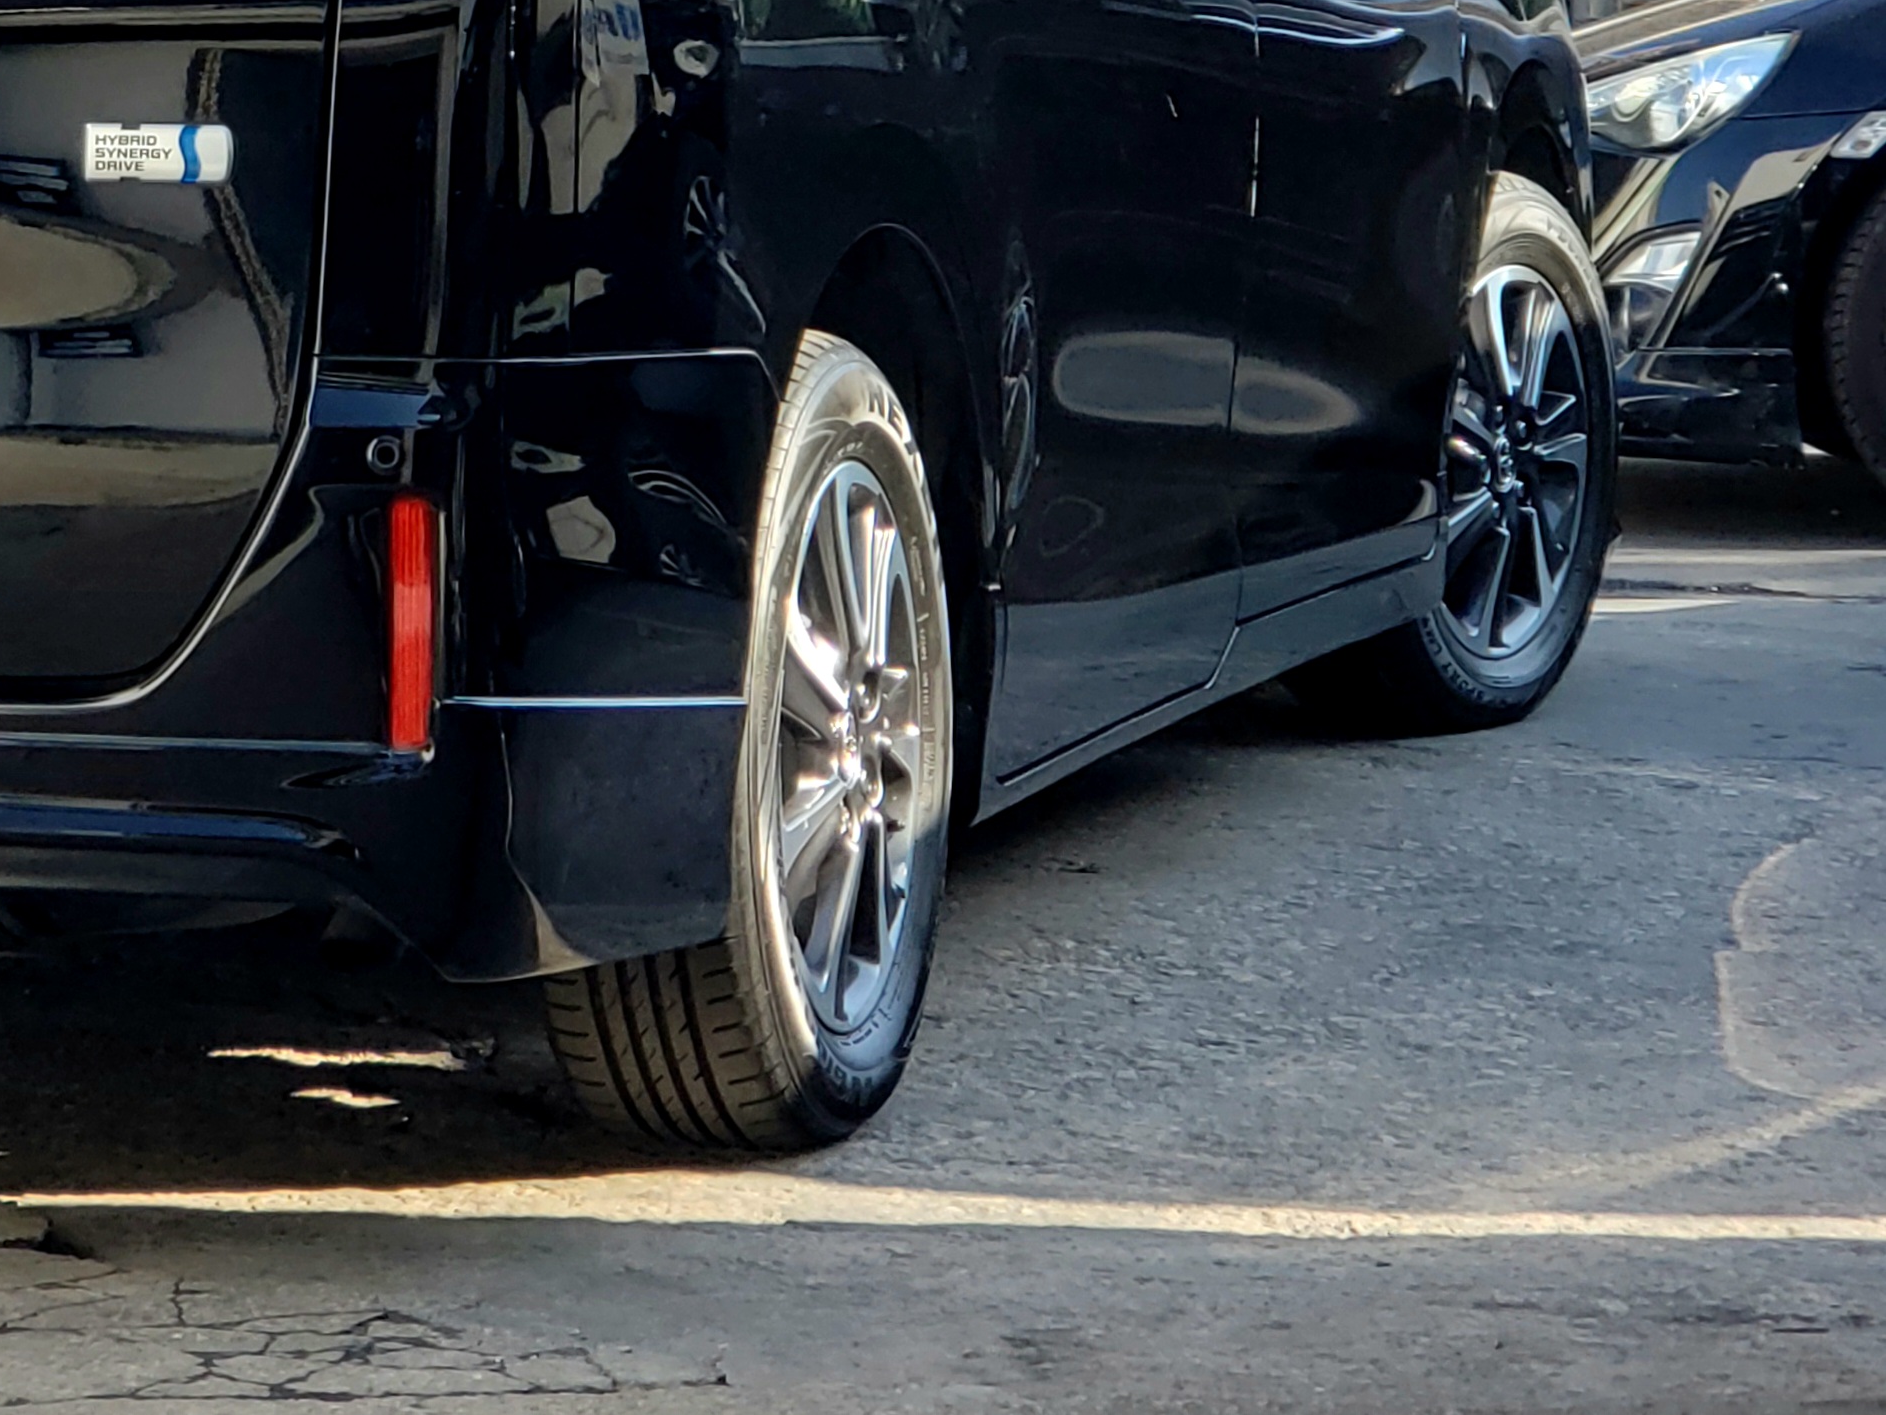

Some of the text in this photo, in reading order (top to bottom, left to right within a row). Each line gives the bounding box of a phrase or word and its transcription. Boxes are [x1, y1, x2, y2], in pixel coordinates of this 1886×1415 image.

[95, 134, 157, 146] HYBRID
[95, 147, 172, 159] SYNERGY
[95, 160, 145, 172] DRIVE
